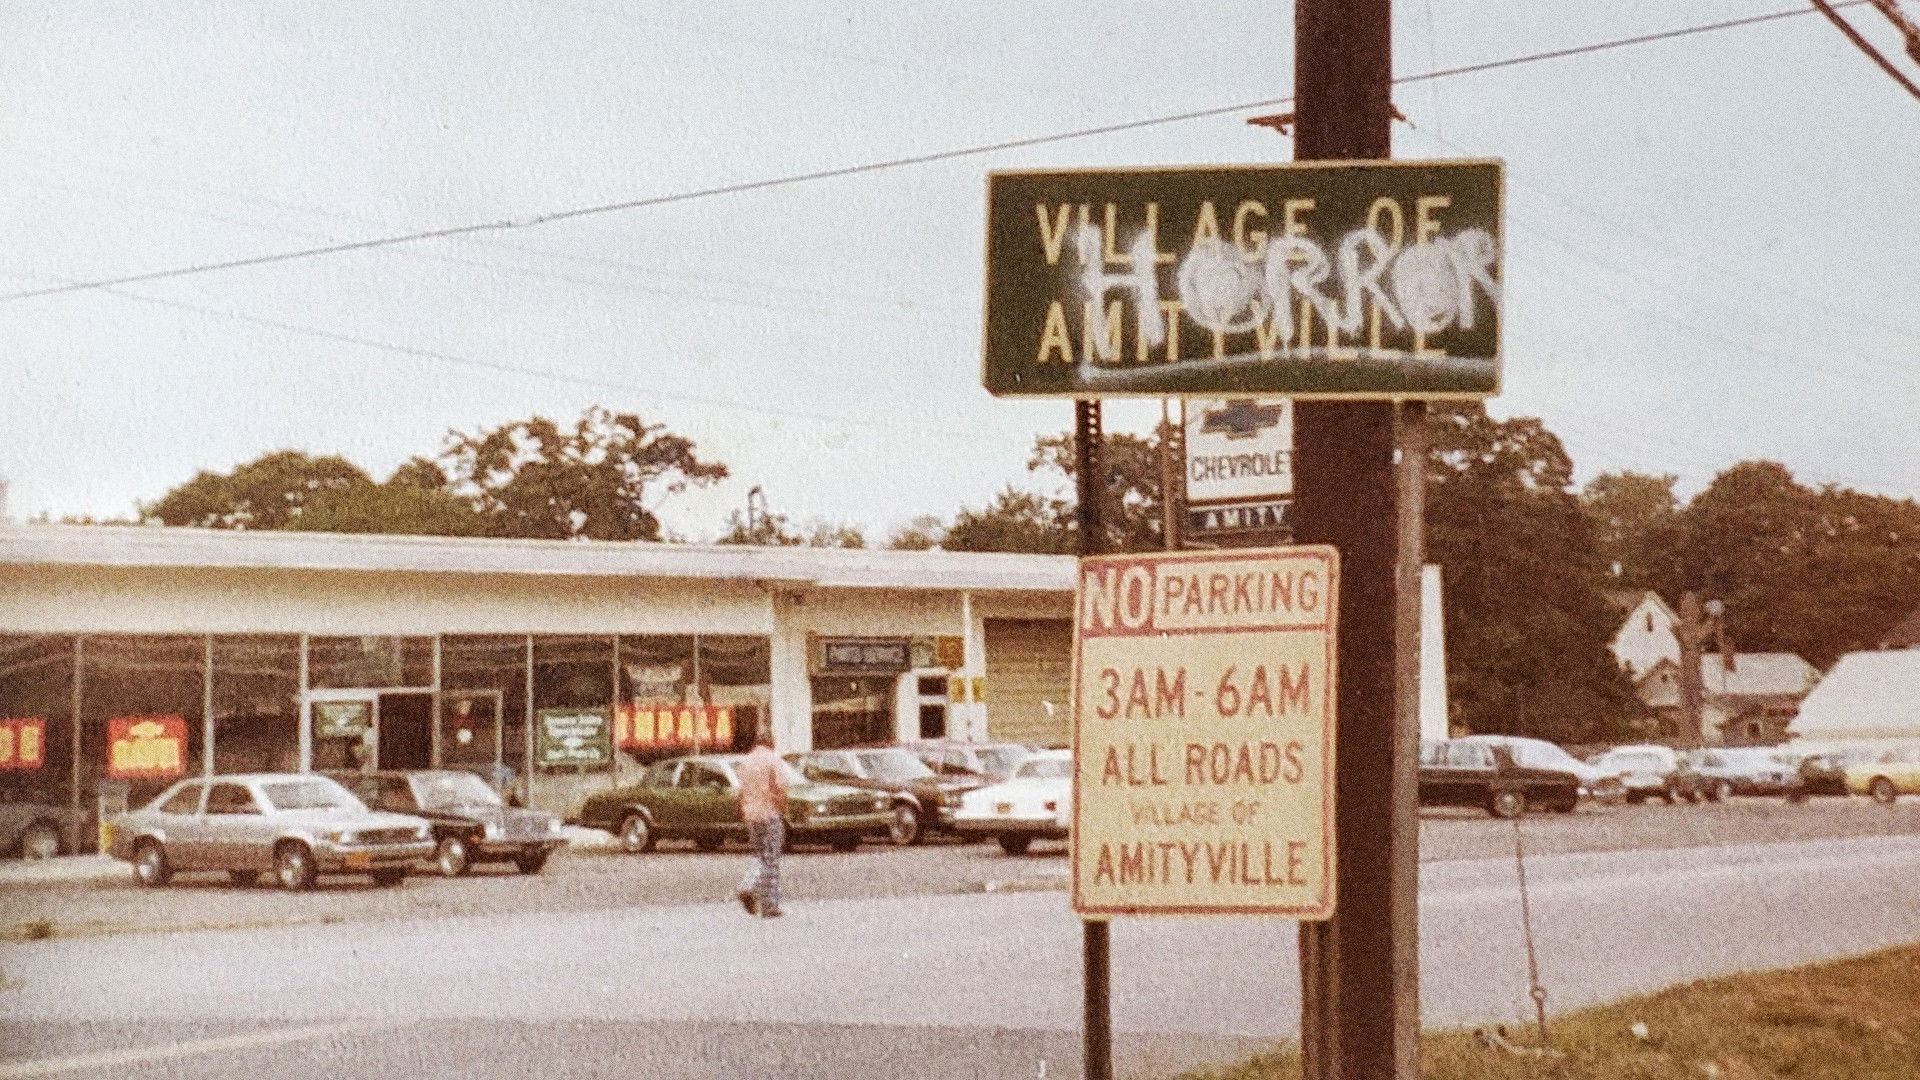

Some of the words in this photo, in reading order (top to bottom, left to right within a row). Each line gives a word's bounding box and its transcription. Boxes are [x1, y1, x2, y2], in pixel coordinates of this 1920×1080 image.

[1036, 198, 1316, 266] VILLAGE
[1366, 196, 1450, 258] OF
[1076, 222, 1499, 350] HORROR
[1205, 504, 1285, 528] AMITY
[1083, 565, 1151, 630] NO
[1162, 569, 1319, 617] PARKING
[1102, 744, 1168, 786] ALL
[1185, 741, 1303, 785] ROADS
[1131, 802, 1219, 826] VILLAGE
[1231, 801, 1260, 825] OF
[1093, 841, 1308, 887] AMITYVILLE
